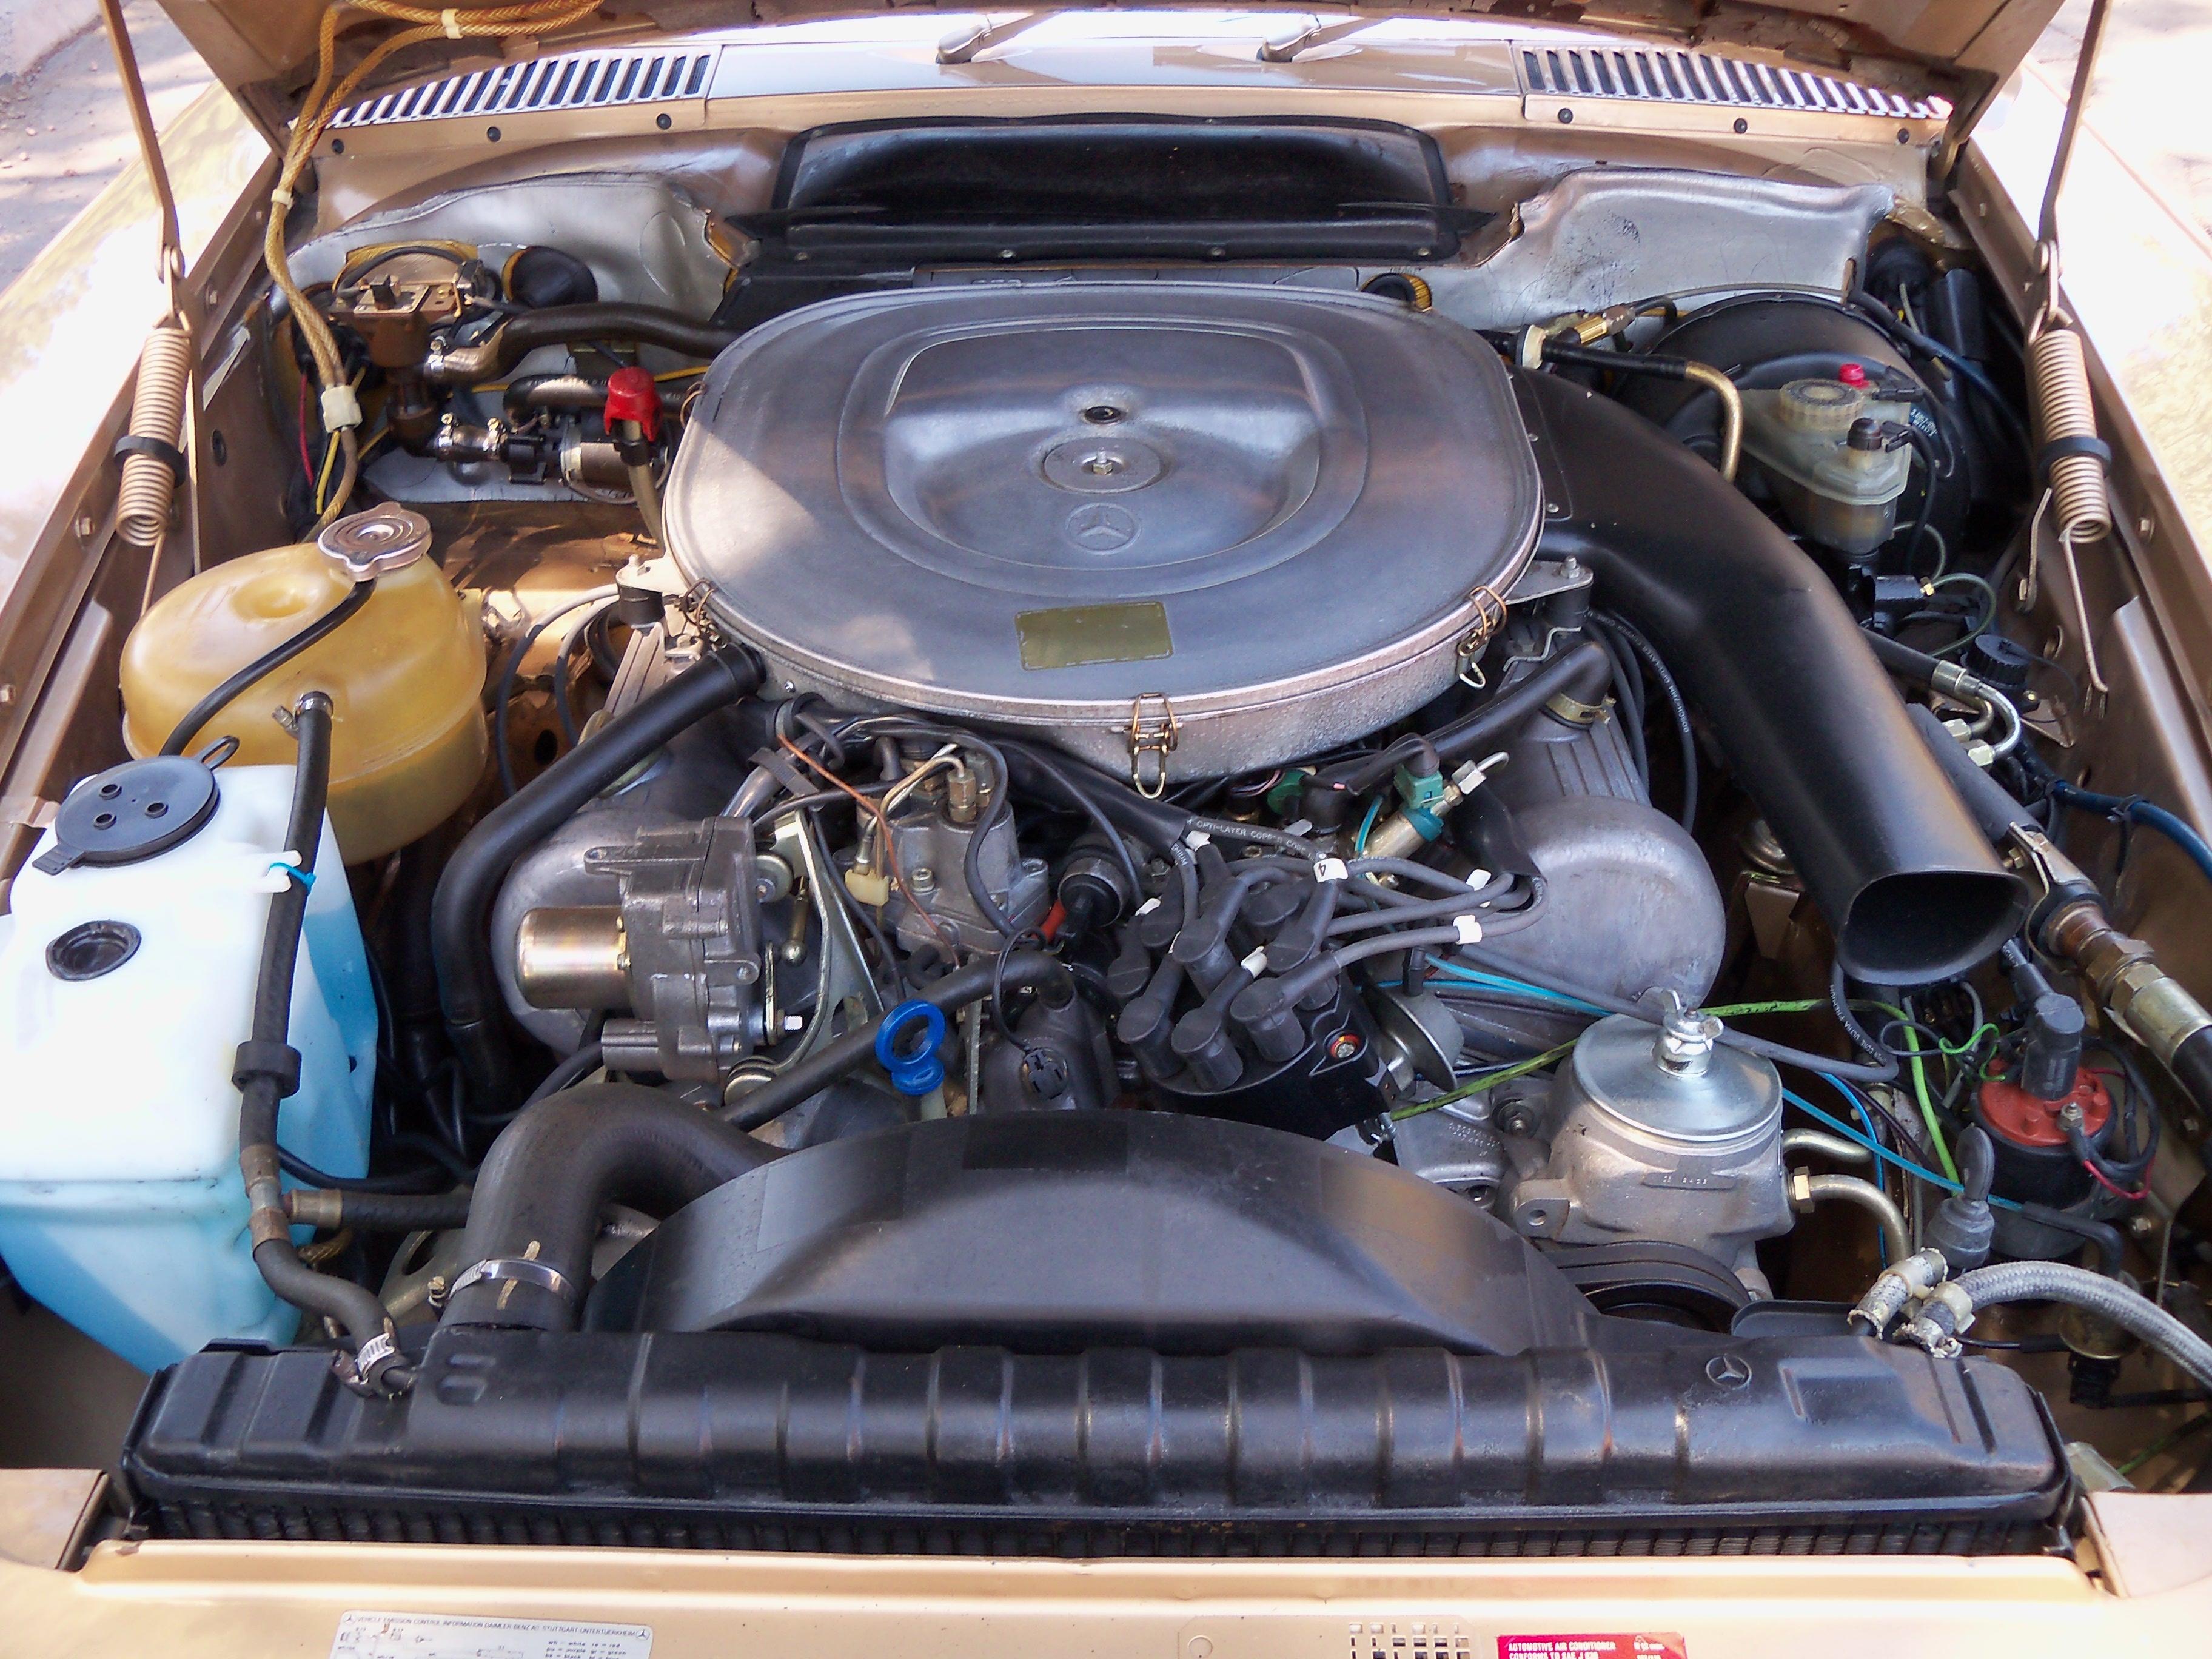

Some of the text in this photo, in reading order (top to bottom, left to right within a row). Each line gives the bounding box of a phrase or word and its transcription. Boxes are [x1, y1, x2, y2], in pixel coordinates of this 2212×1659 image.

[1196, 820, 1247, 837] OPTI-LAYER
[1318, 862, 1327, 877] 4
[1508, 1641, 1617, 1651] AUTOMOTIVE AIR CONDITIONER
